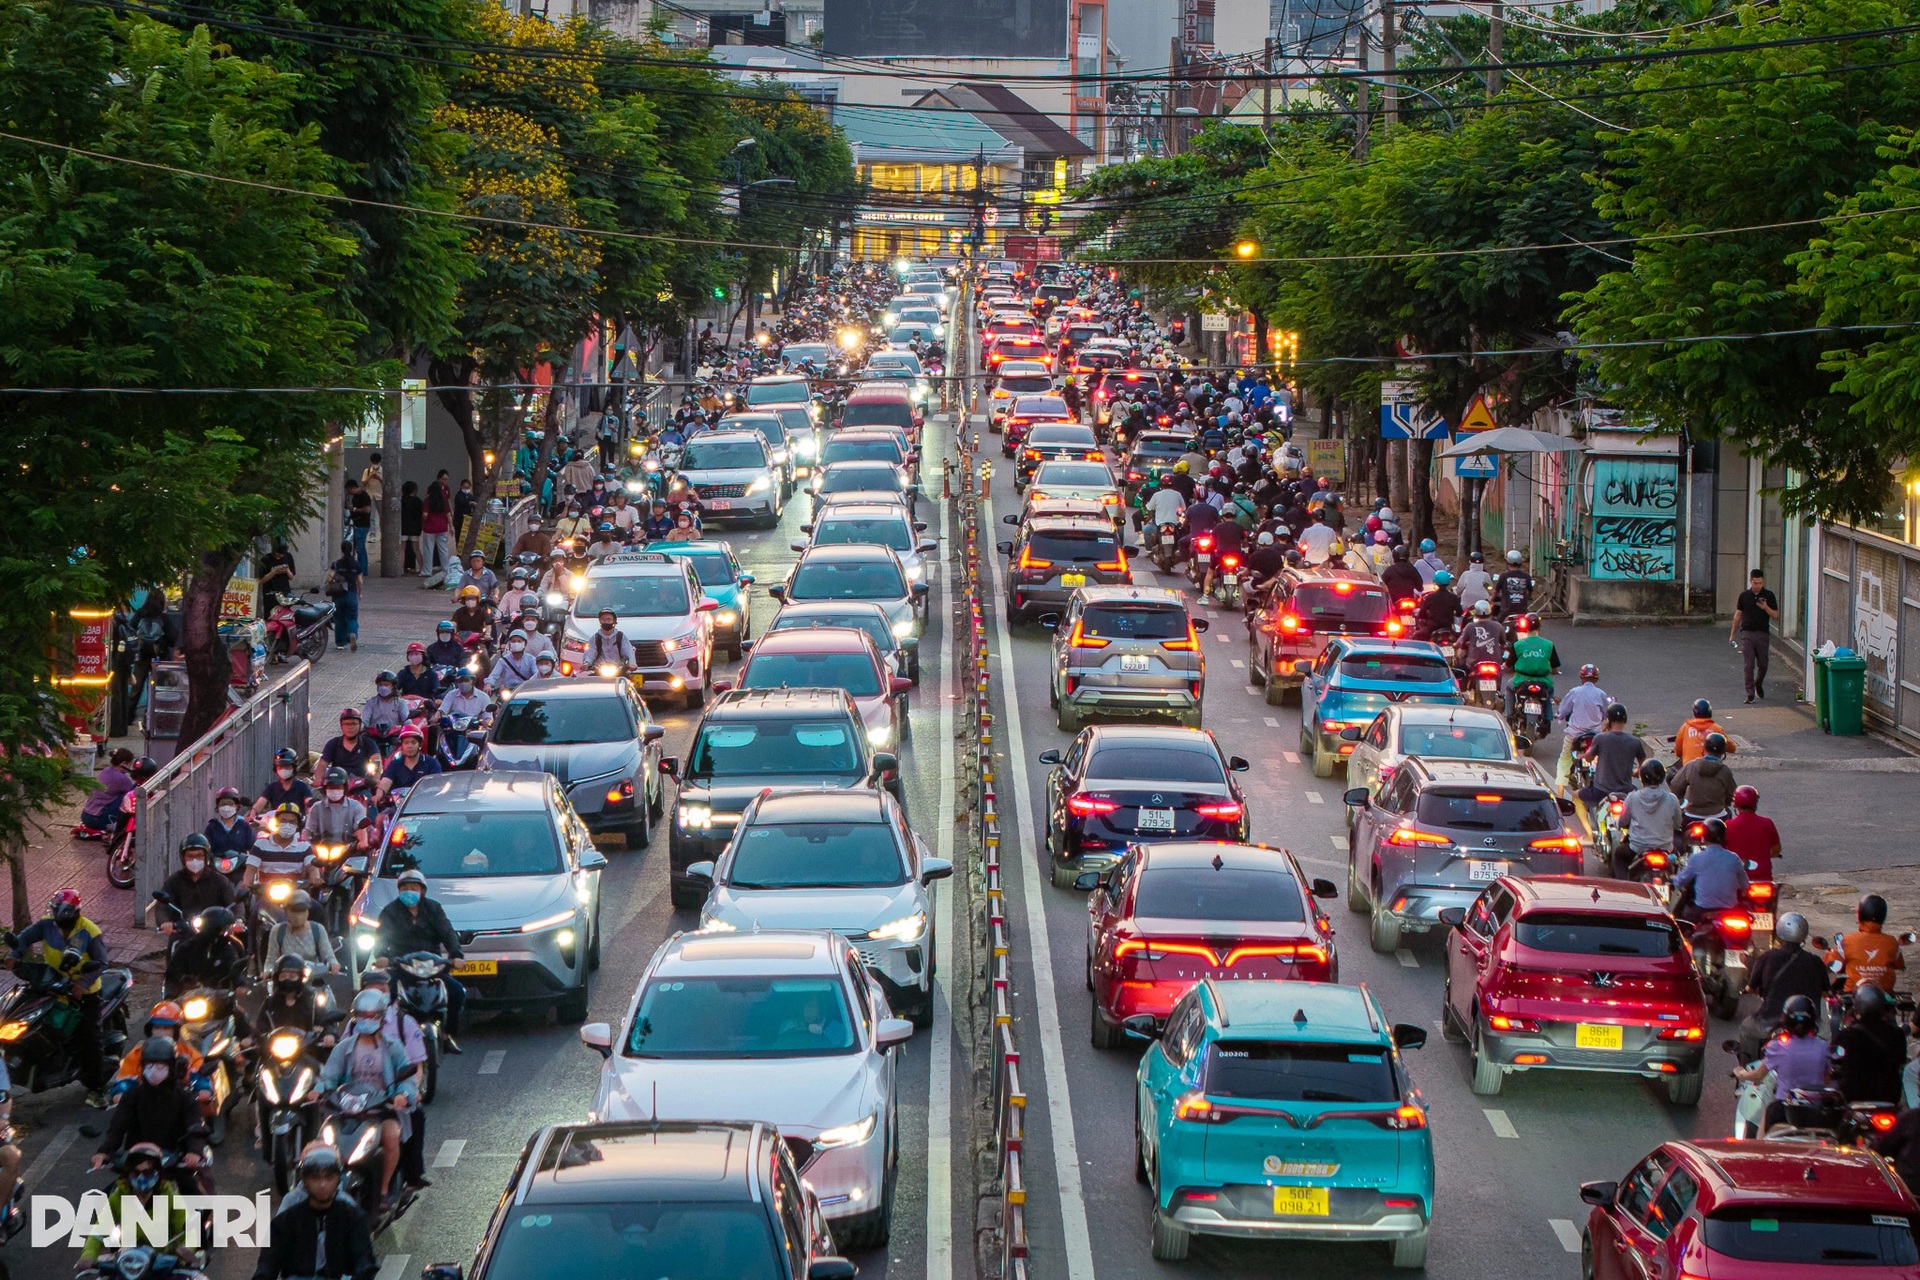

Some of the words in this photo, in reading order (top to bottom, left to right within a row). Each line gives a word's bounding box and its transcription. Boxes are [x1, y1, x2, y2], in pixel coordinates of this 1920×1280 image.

[912, 213, 945, 221] COFFEE
[80, 625, 101, 635] BAB
[77, 655, 100, 664] TACOS
[80, 666, 97, 674] 24K
[1148, 811, 1164, 819] 51L
[1142, 819, 1171, 828] 279.25
[1480, 862, 1497, 871] 51L
[1178, 970, 1268, 980] VINFAST
[1590, 1026, 1610, 1037] 86H
[1289, 1188, 1313, 1200] 50E
[1279, 1200, 1322, 1213] 098.21
